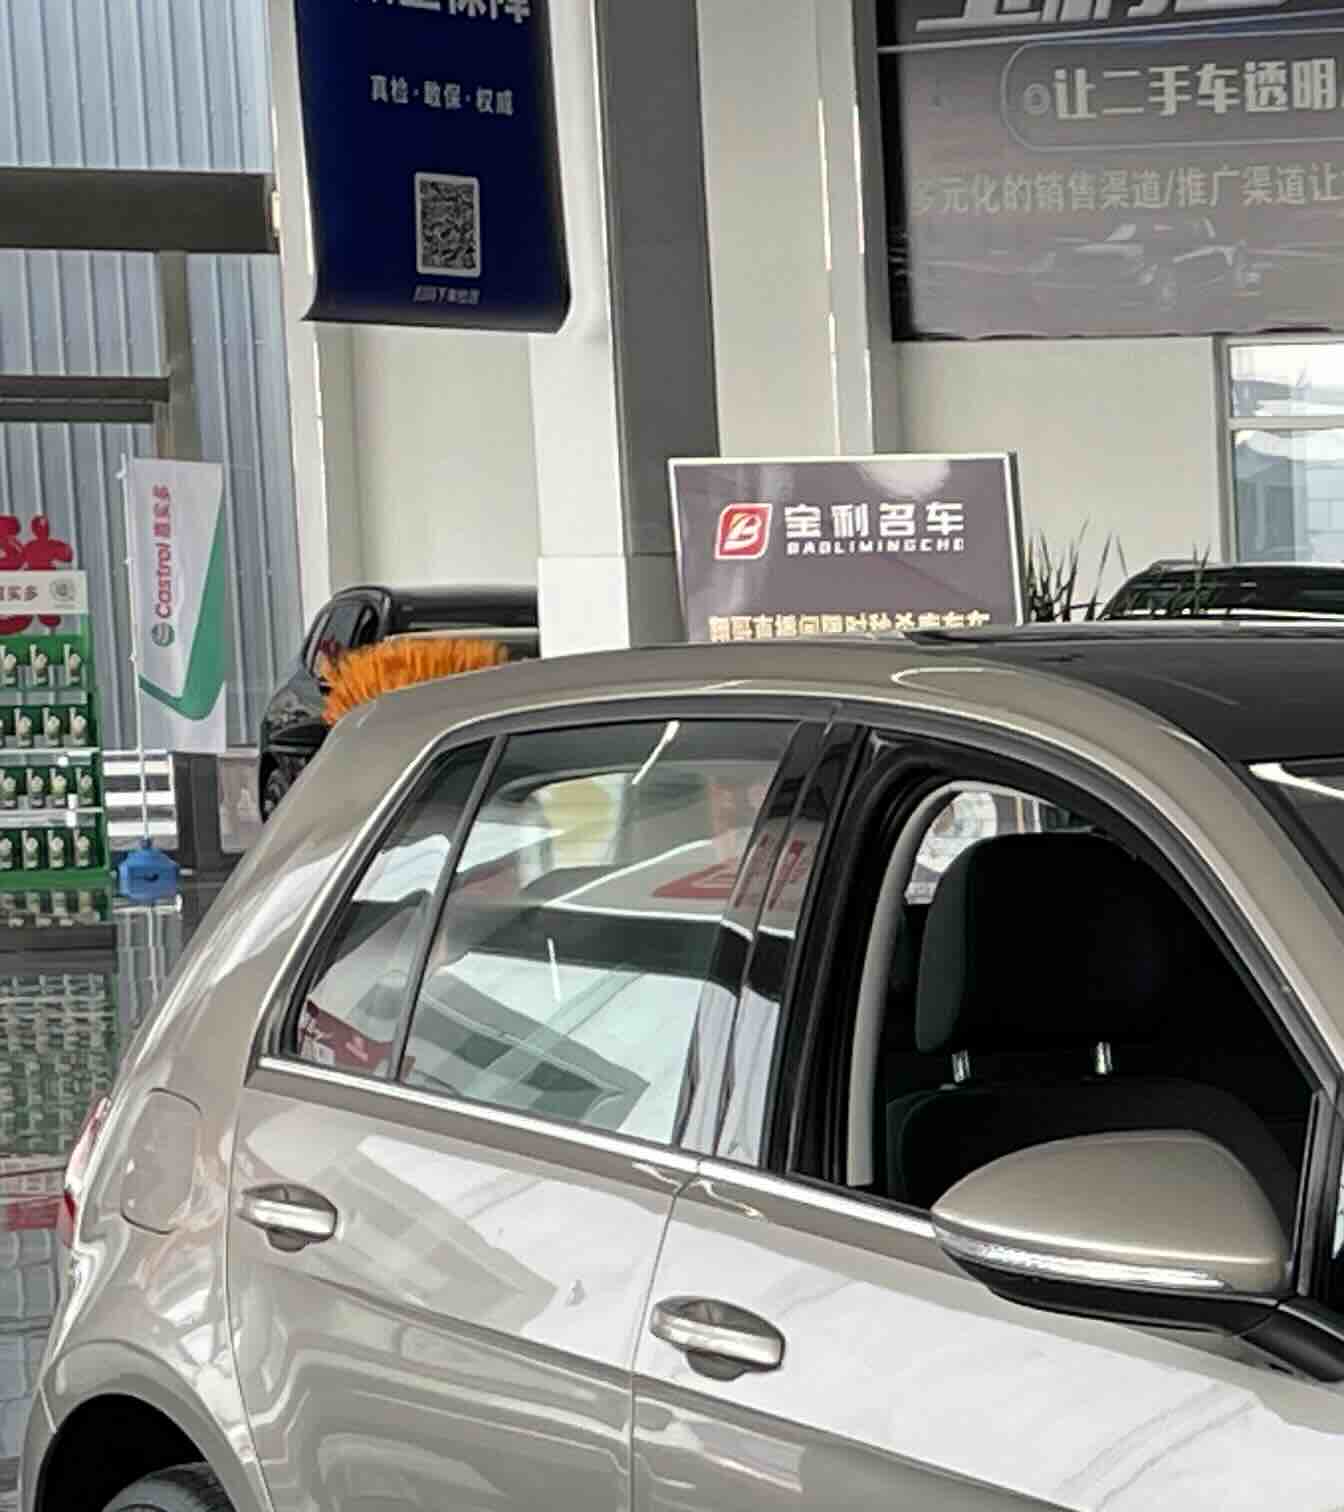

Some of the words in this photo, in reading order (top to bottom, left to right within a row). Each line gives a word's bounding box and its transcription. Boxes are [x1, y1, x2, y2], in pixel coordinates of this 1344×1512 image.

[783, 501, 965, 539] 宝利名车
[154, 541, 173, 618] Castrol
